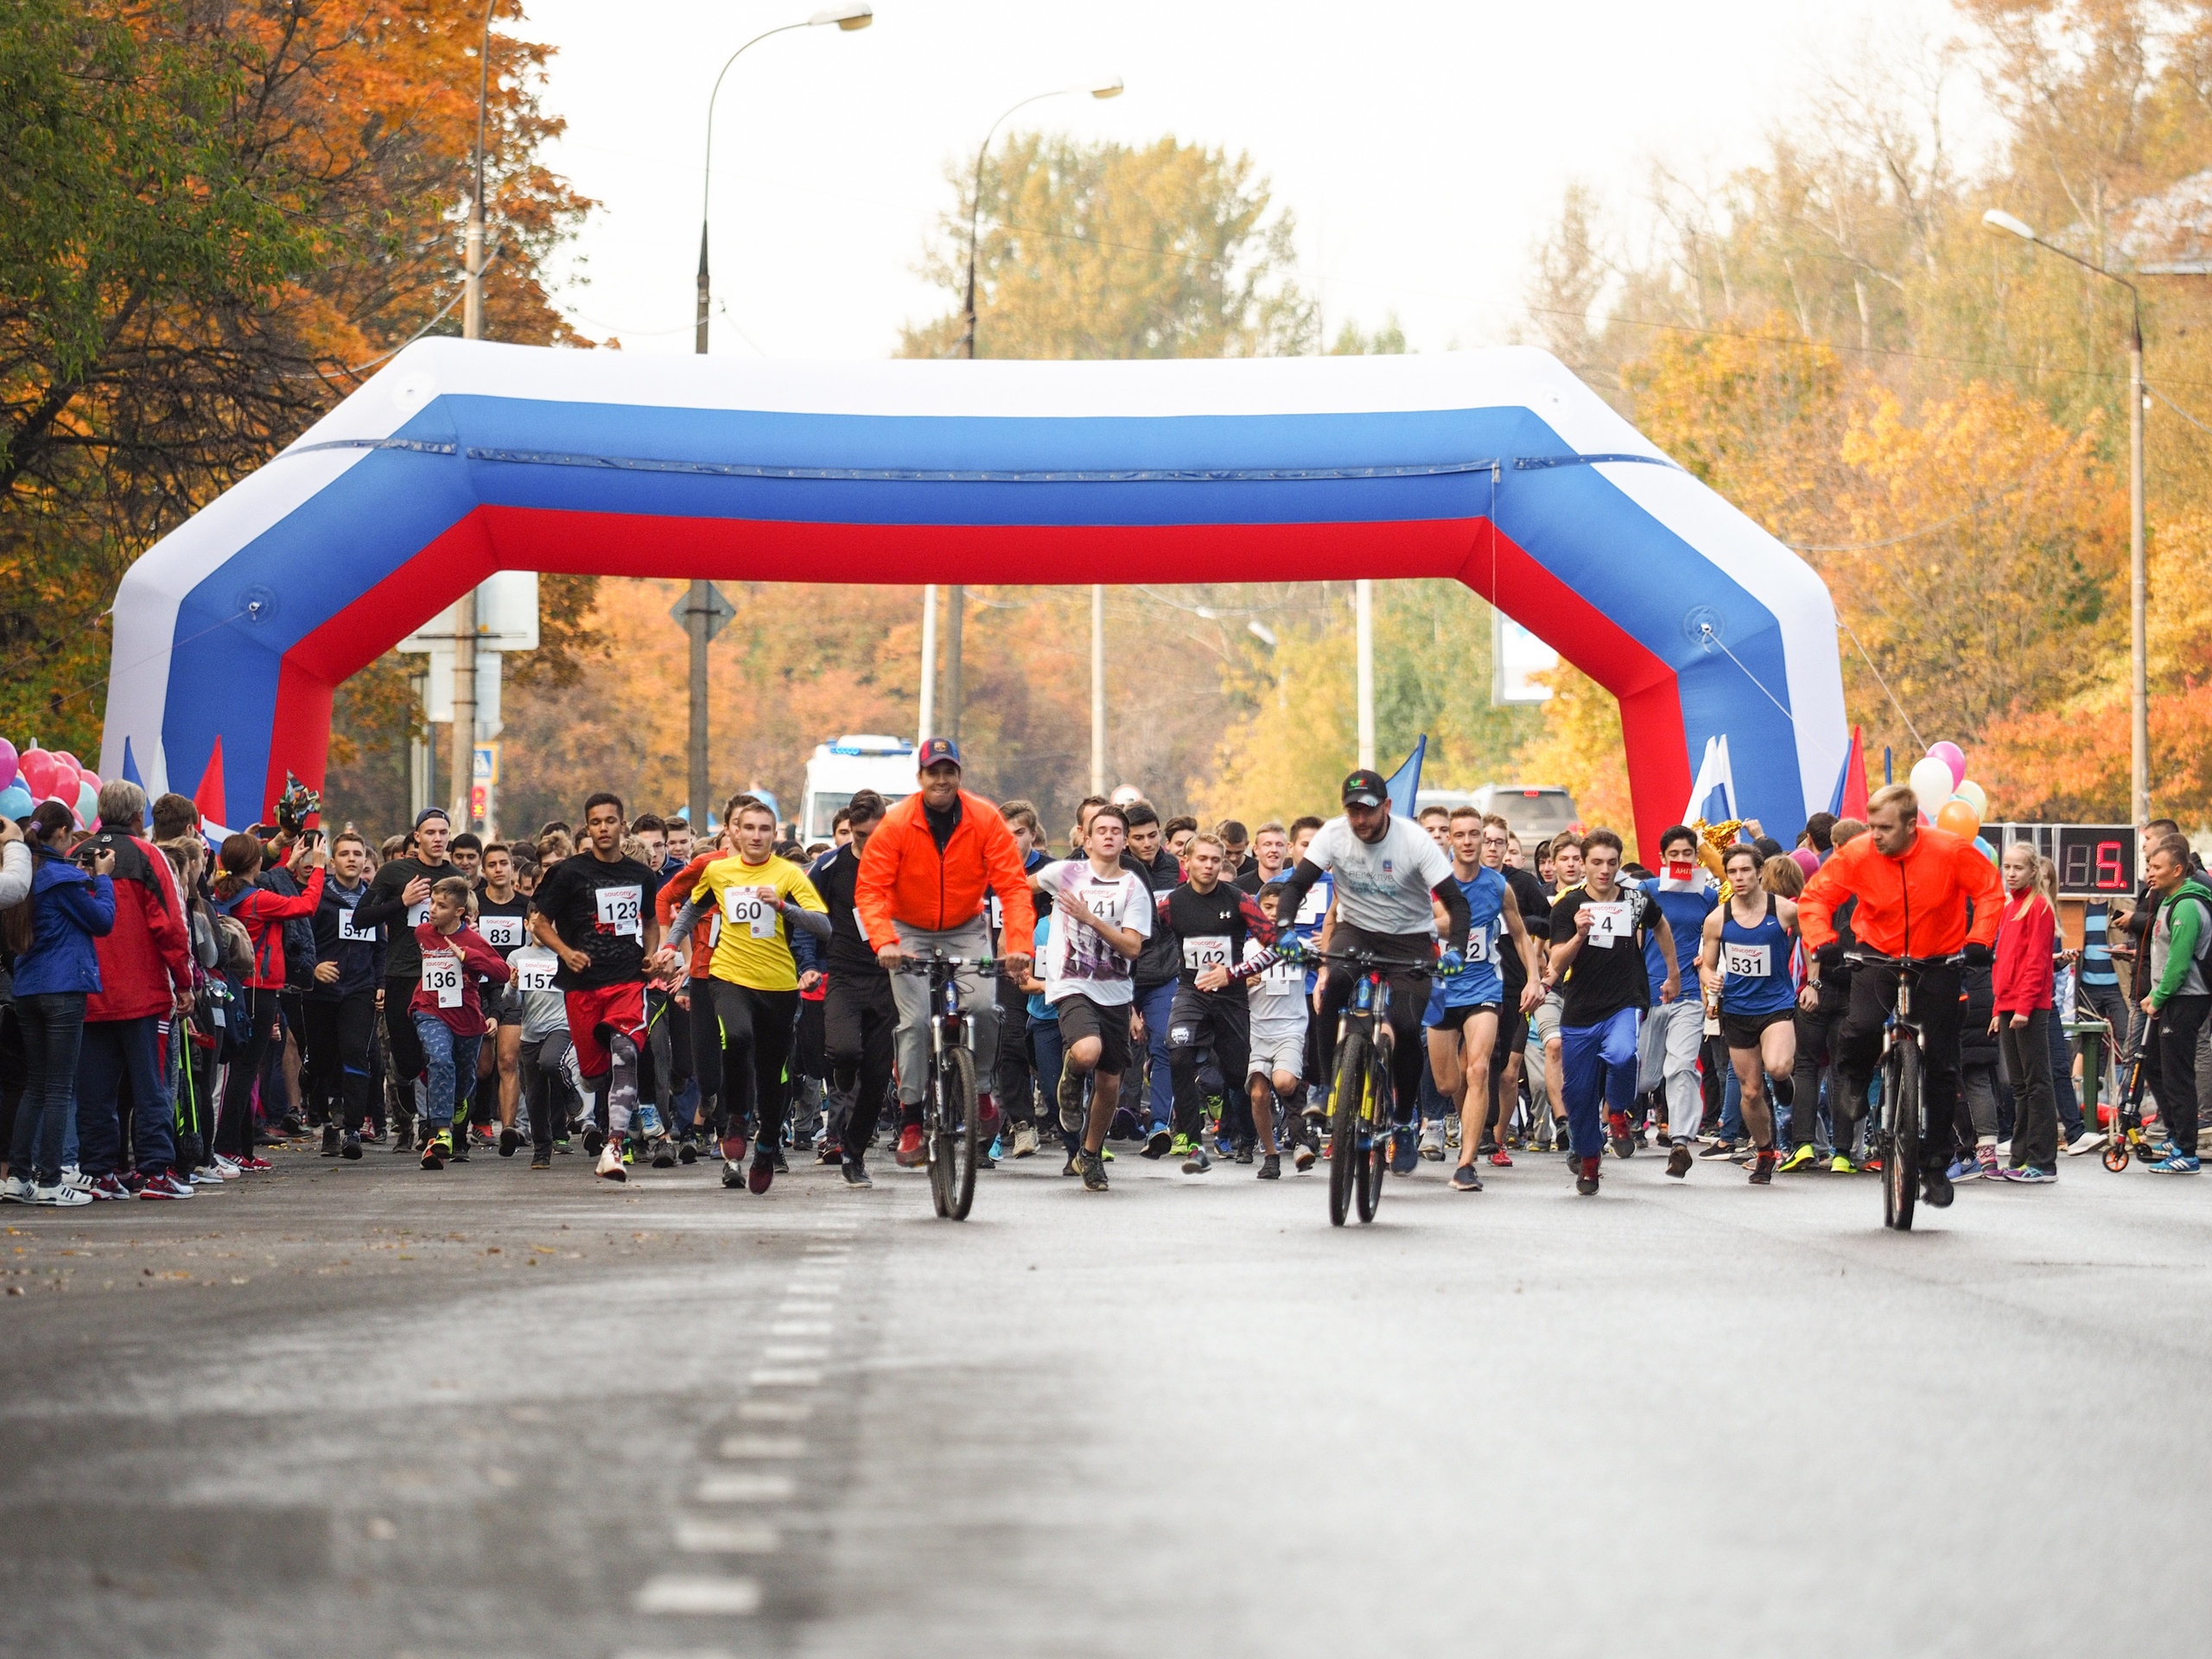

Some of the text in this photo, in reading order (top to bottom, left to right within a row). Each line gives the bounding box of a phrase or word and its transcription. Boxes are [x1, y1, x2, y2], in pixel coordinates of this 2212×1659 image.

[605, 901, 638, 921] 123
[735, 901, 762, 919] 60
[1601, 916, 1613, 933] 4
[490, 930, 511, 944] 83
[1191, 950, 1225, 967] 142
[1732, 957, 1762, 974] 531
[426, 971, 456, 988] 136
[524, 973, 556, 989] 157
